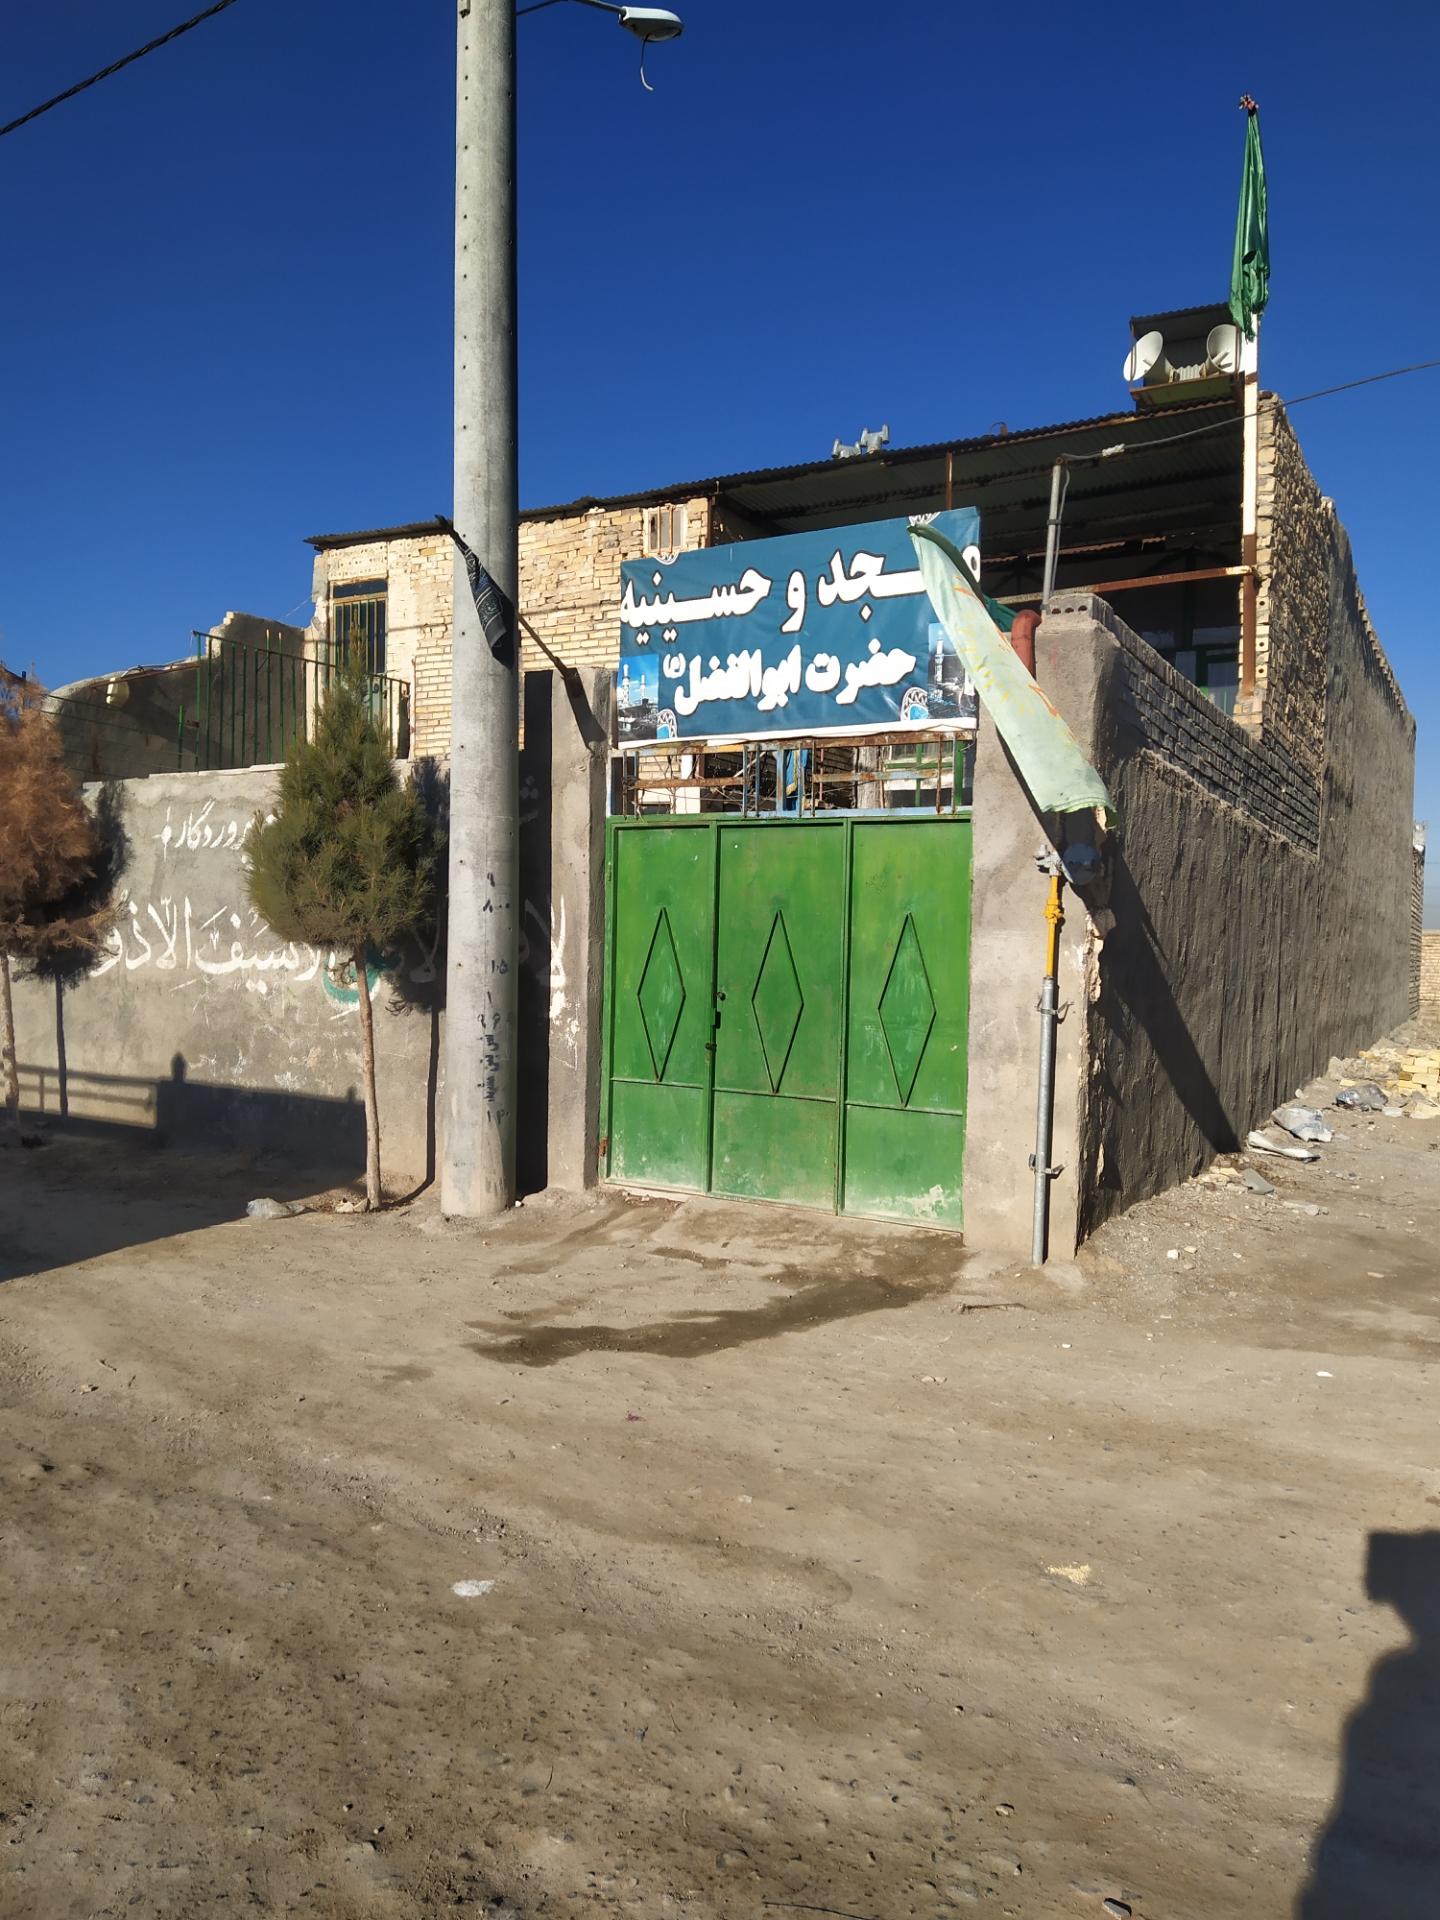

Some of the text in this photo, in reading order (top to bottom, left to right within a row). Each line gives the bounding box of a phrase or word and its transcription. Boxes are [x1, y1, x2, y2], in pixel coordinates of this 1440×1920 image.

[619, 544, 981, 645] مجد و حسینیه
[804, 637, 917, 705] حضرت
